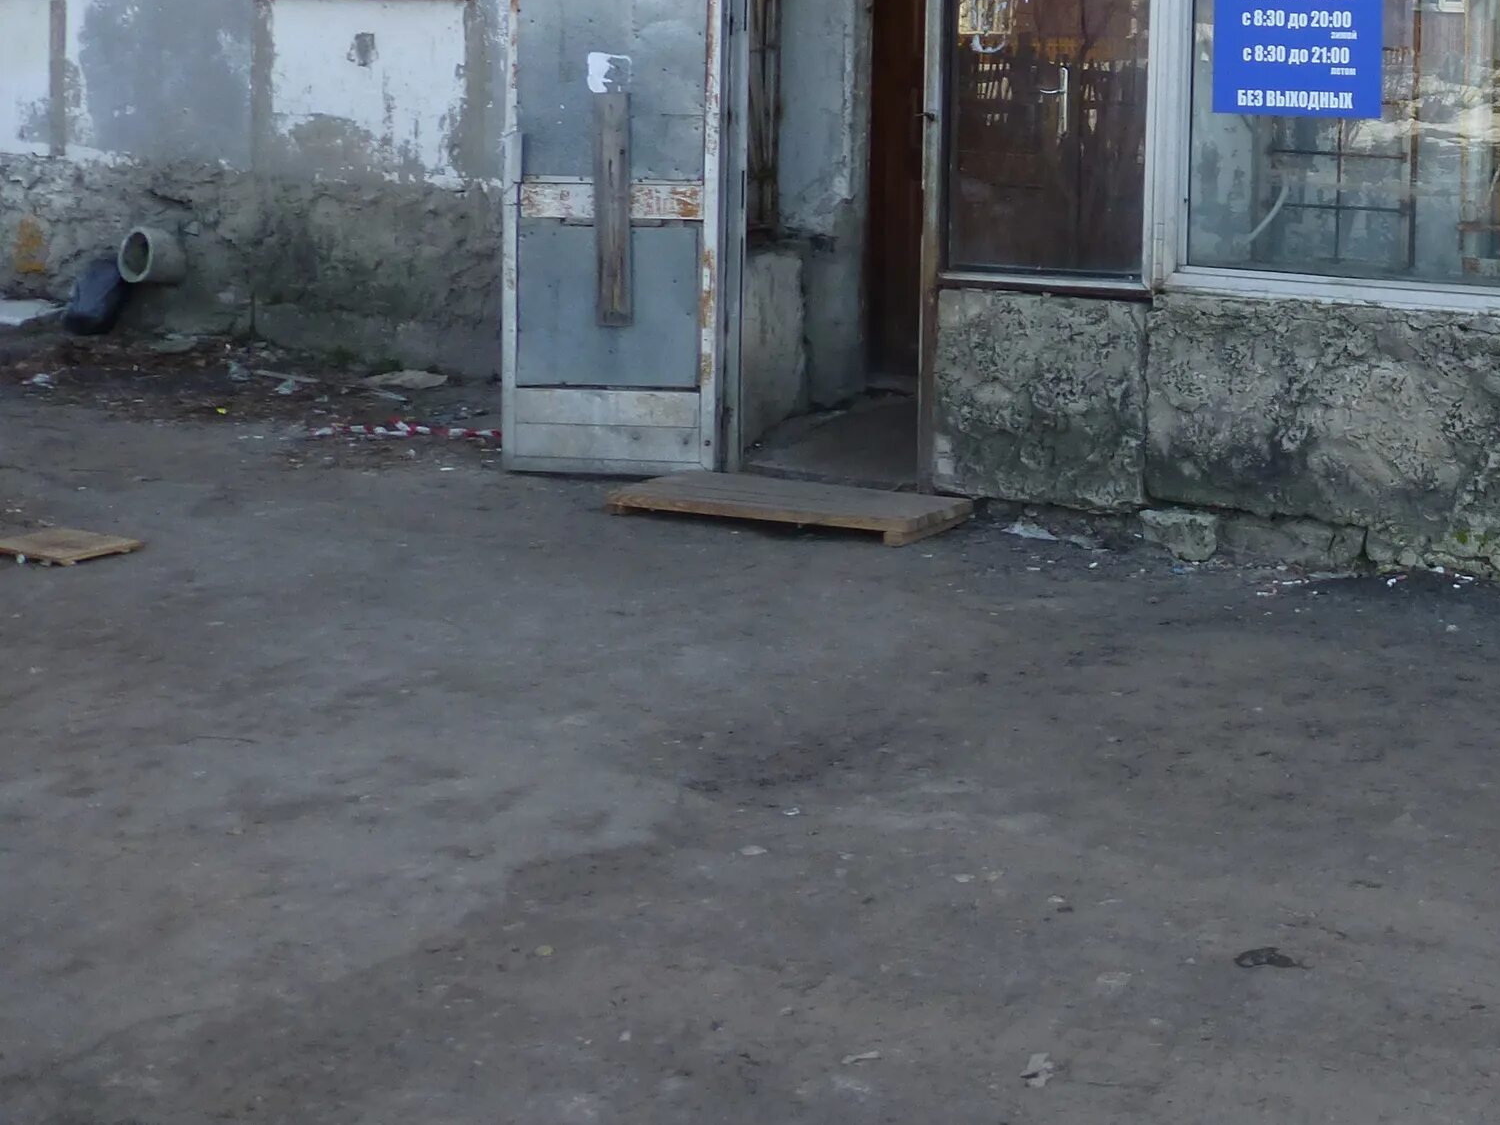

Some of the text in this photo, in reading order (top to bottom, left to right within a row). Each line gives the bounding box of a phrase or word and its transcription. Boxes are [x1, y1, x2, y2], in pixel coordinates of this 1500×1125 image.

[1242, 9, 1352, 29] с 8:30 до 20:00
[1242, 44, 1350, 65] с 8:30 до 21:00
[1237, 89, 1353, 111] БЕЗ ВЫХОДНЫХ
